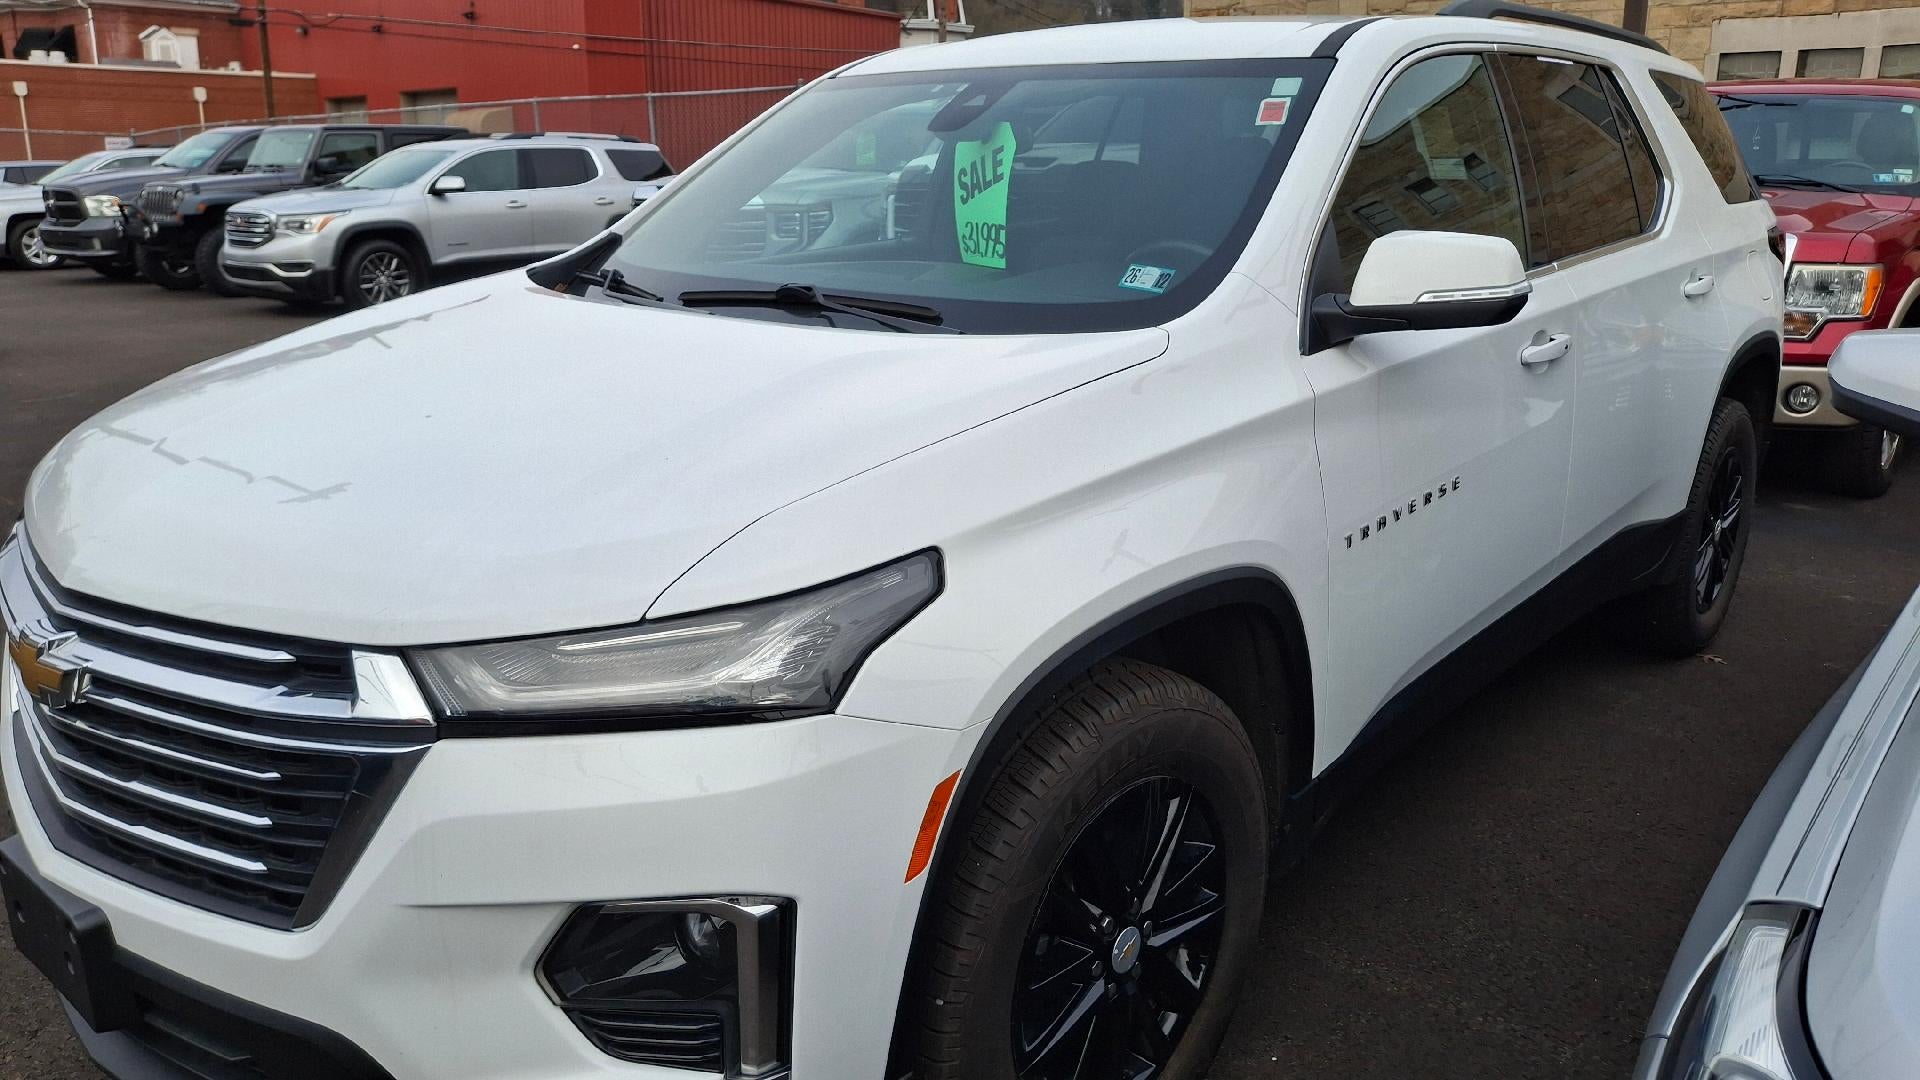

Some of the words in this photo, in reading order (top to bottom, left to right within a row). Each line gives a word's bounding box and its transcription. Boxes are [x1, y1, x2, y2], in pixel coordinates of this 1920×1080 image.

[958, 145, 1004, 205] SALE
[1124, 267, 1141, 284] 26
[1152, 272, 1171, 288] 12
[1344, 476, 1460, 549] TRAVERSE
